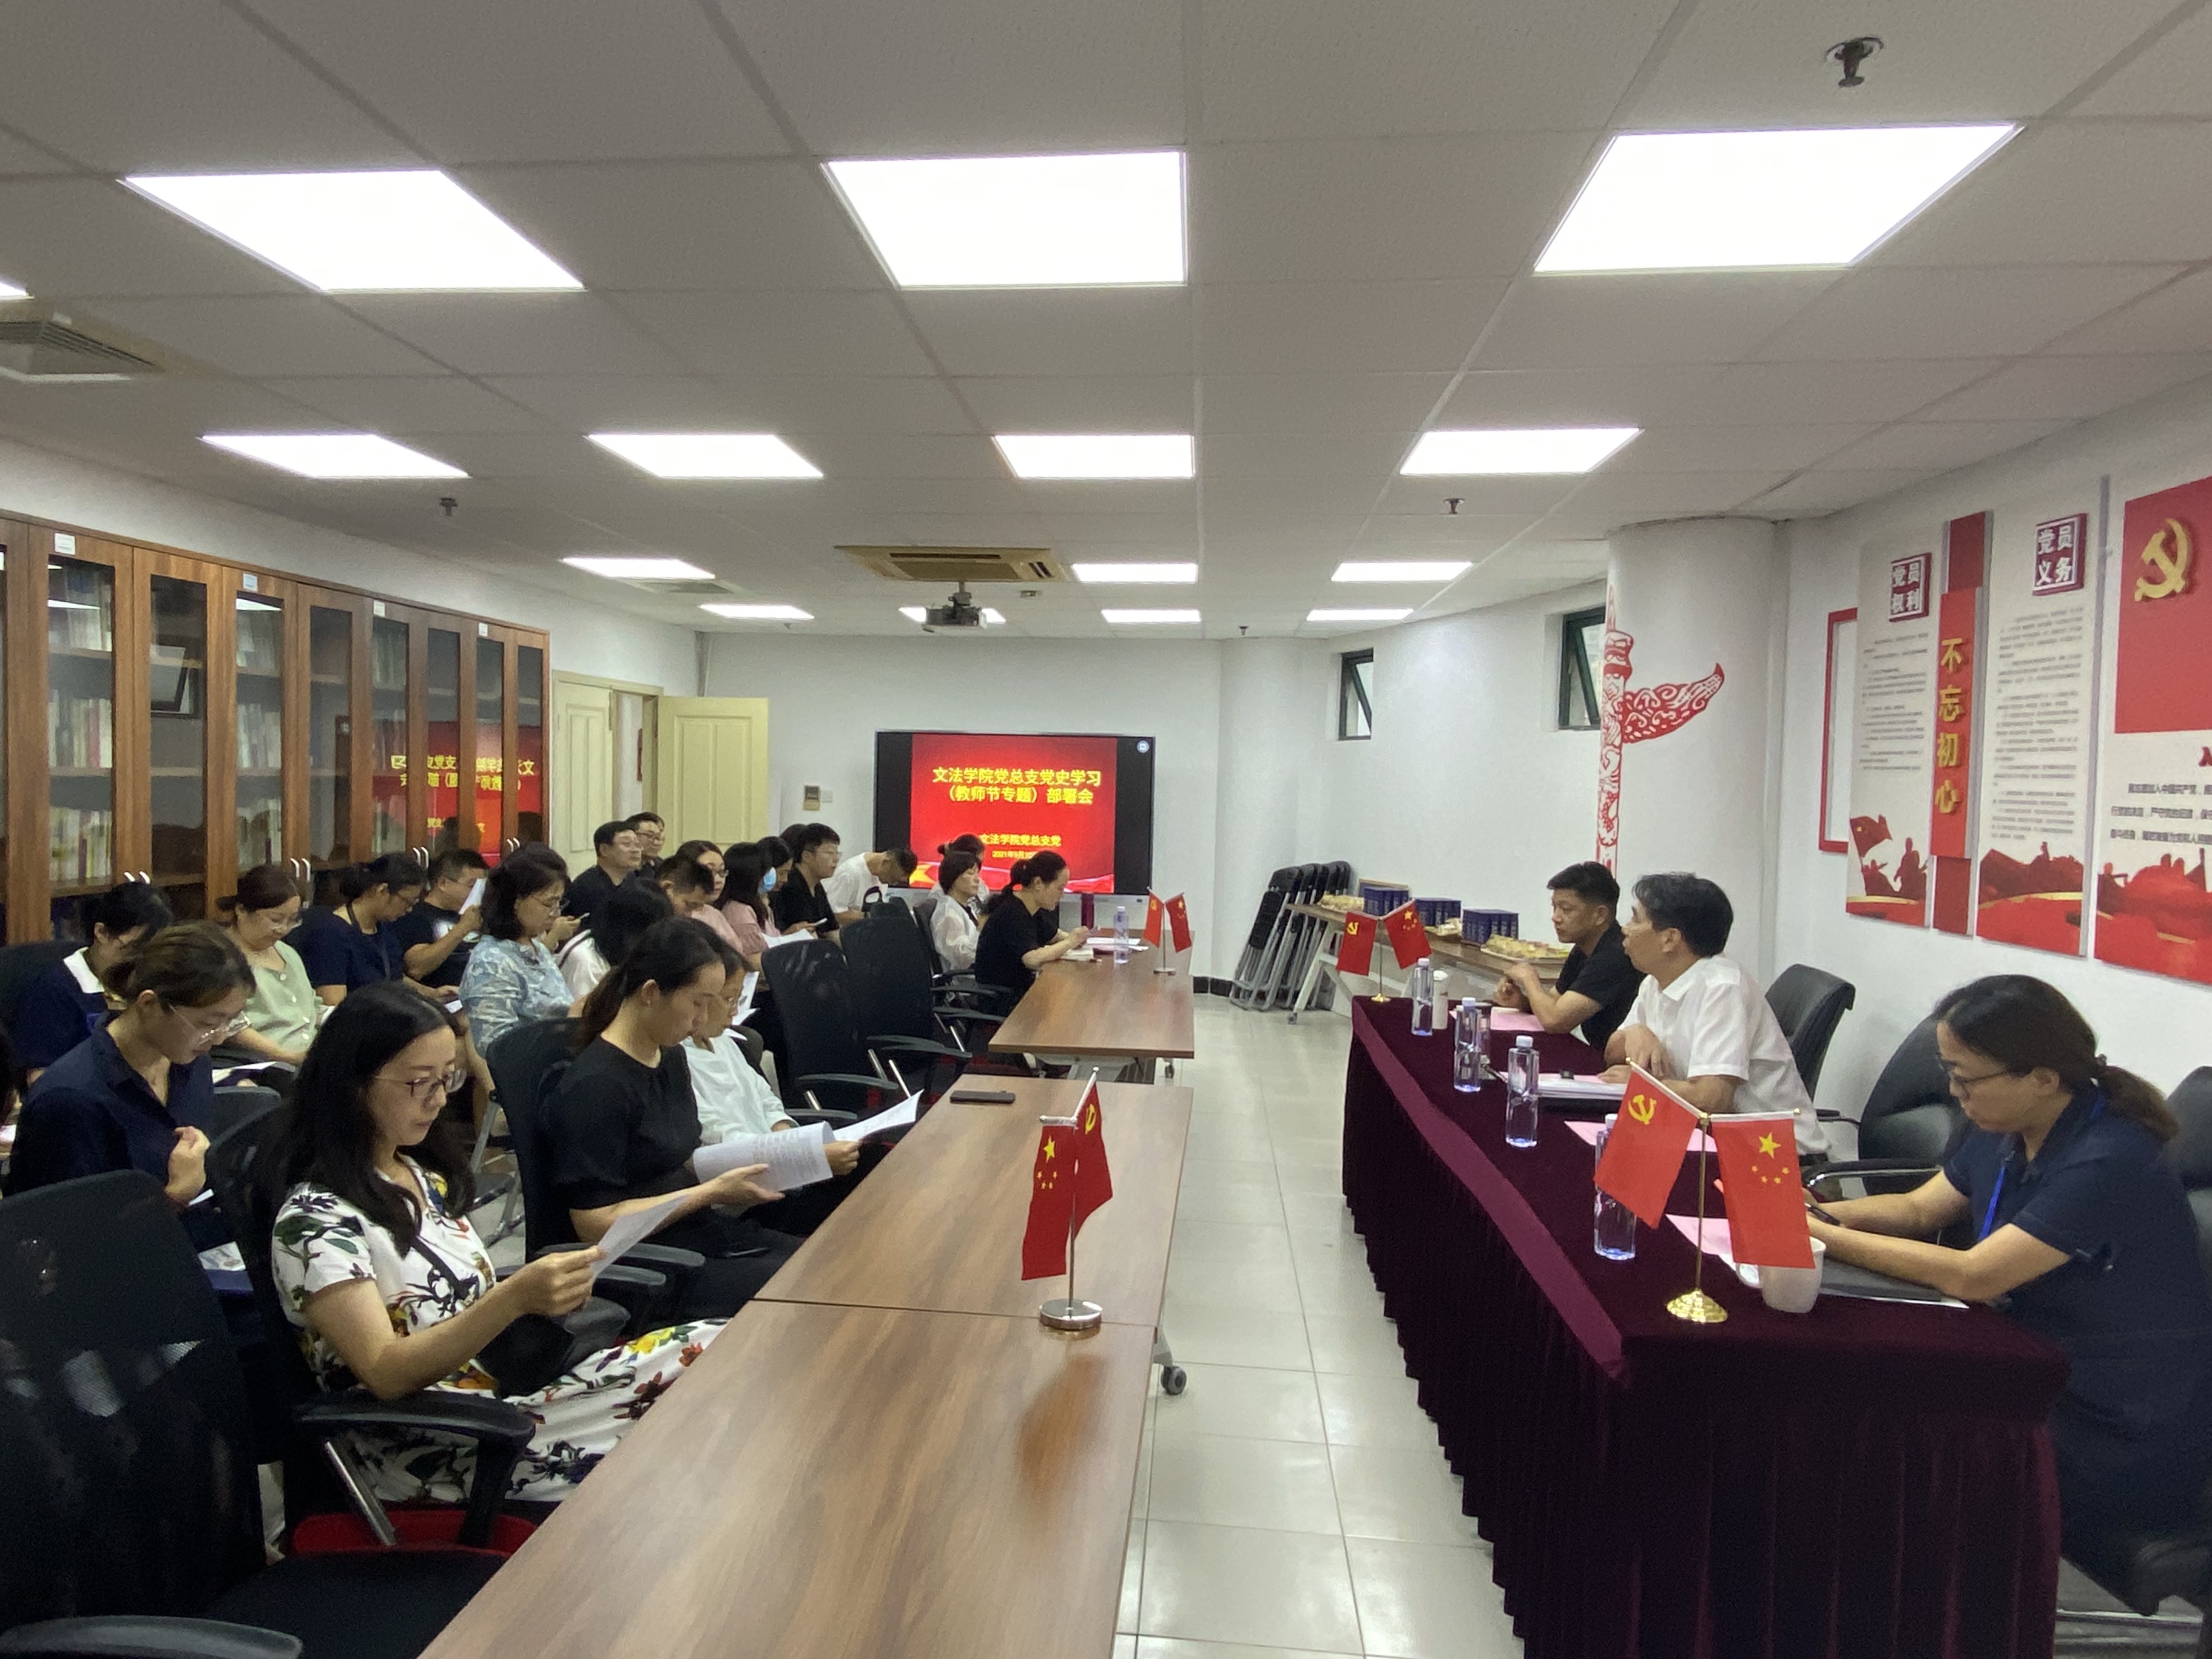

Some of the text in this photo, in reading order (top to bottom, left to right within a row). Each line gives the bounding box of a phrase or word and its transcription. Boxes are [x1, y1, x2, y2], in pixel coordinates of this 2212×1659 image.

[2037, 524, 2072, 555] 党员
[1892, 563, 1920, 586] 党员
[2035, 556, 2072, 586] 义务
[1935, 637, 1963, 814] 不忘初心
[932, 766, 1102, 786] 文法学院党总支党史学习
